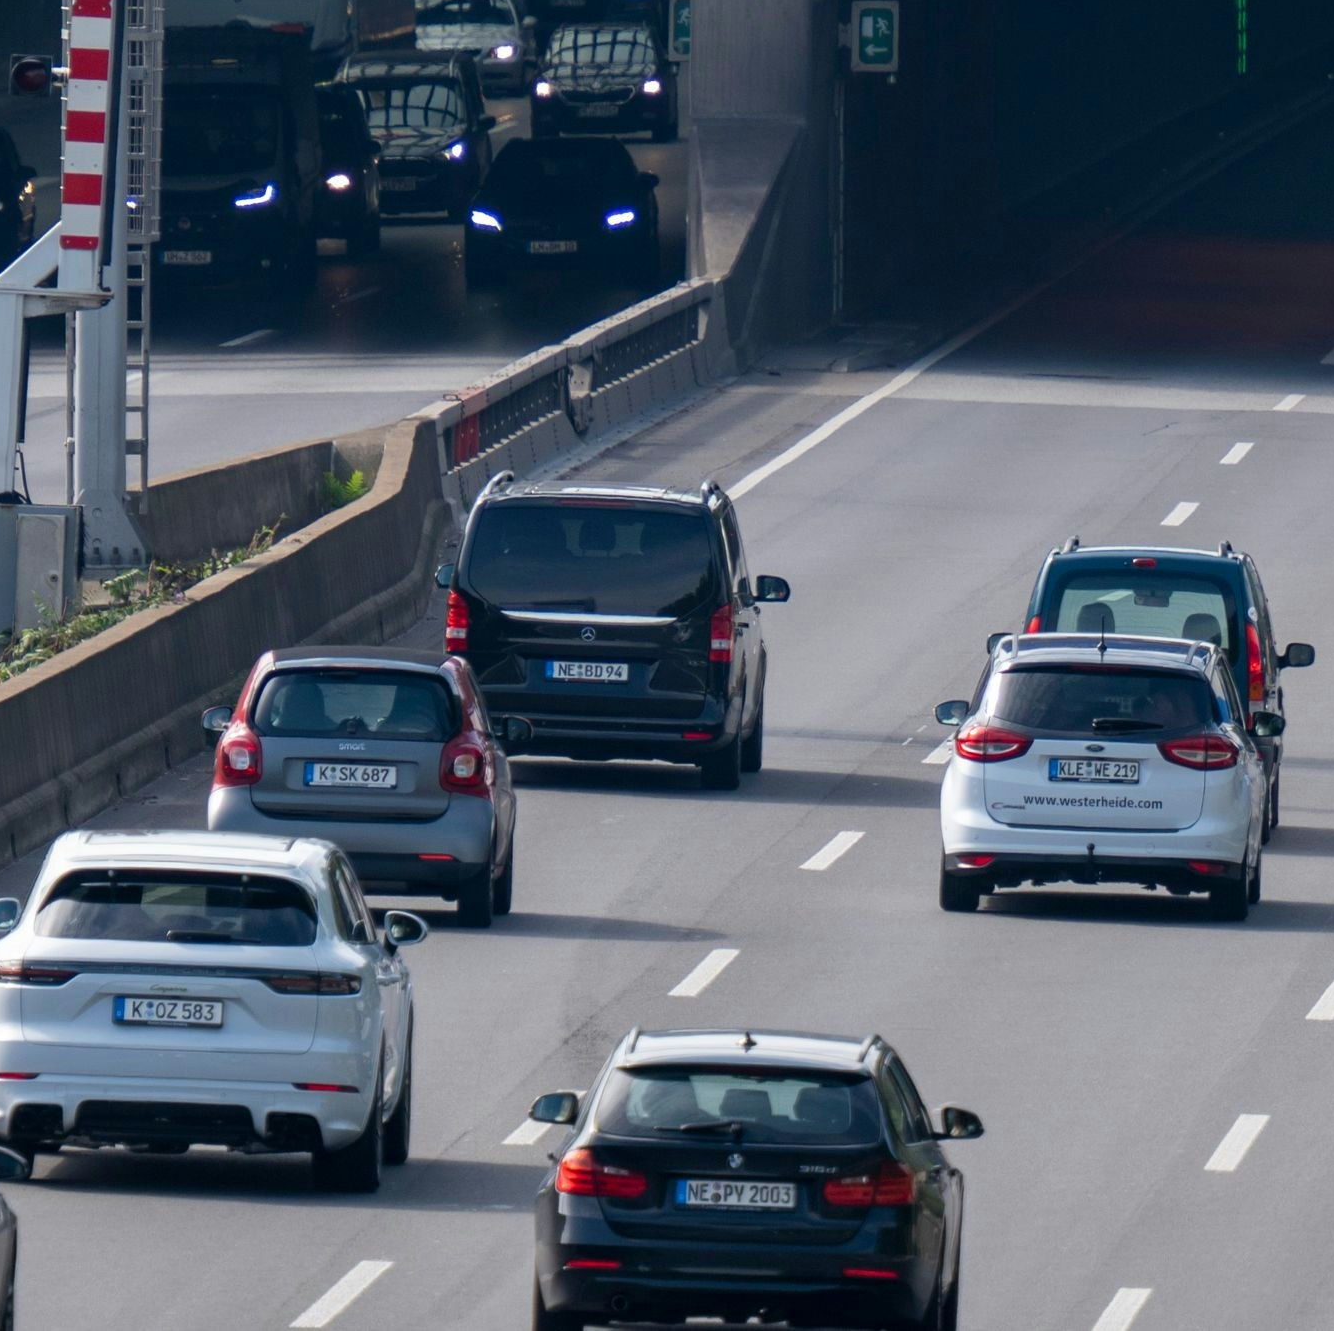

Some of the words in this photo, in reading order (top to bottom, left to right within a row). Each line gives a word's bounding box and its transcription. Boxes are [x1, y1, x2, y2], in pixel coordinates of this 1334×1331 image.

[558, 663, 575, 677] NE
[585, 664, 603, 678] BD
[606, 665, 623, 679] 94
[339, 743, 366, 751] smart
[319, 765, 329, 780] K
[339, 766, 357, 781] SK
[361, 768, 389, 782] 687
[1059, 761, 1084, 776] KLE
[1094, 763, 1110, 777] WE
[1113, 764, 1137, 778] 219
[1023, 795, 1163, 809] www.westerheide.com
[132, 1000, 143, 1018] K
[156, 1002, 179, 1019] OZ
[182, 1003, 215, 1021] 583
[688, 1182, 709, 1201] NE
[723, 1184, 746, 1202] PY
[749, 1186, 791, 1204] 2003
